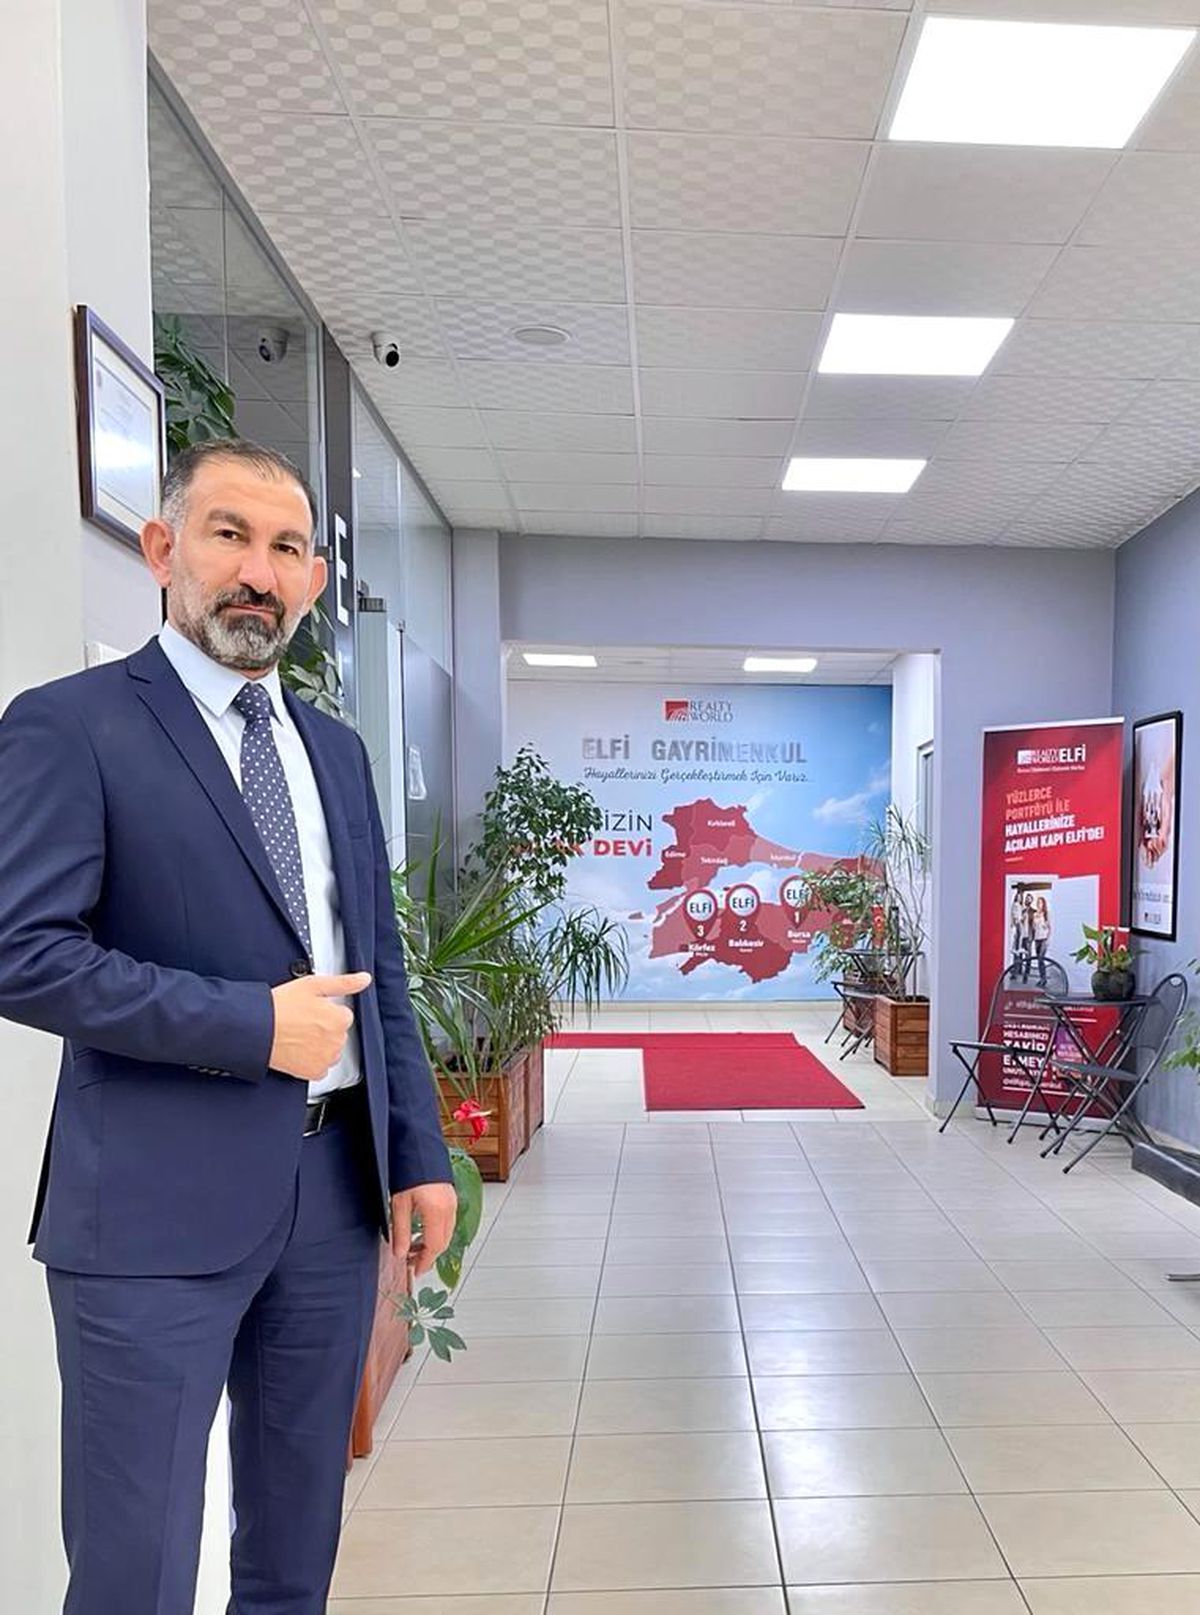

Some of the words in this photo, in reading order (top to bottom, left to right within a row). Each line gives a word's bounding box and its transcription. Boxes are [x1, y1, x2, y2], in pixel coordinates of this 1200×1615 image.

[689, 700, 733, 711] REALTY
[689, 711, 734, 723] WORLD
[582, 734, 631, 760] ELFİ
[652, 736, 808, 764] GAYRİMENKUL
[1059, 743, 1086, 763] ELFİ
[1006, 786, 1052, 805] YÜZLERCE
[1005, 814, 1076, 837] HAYALLERİNİZE
[593, 838, 653, 857] DEVİ
[1004, 836, 1039, 854] AÇILAN
[1040, 832, 1064, 848] KAPI
[690, 903, 712, 914] ELFİ
[732, 896, 754, 909] ELFİ
[794, 911, 800, 923] 1
[697, 925, 705, 937] 3
[739, 920, 747, 932] 2
